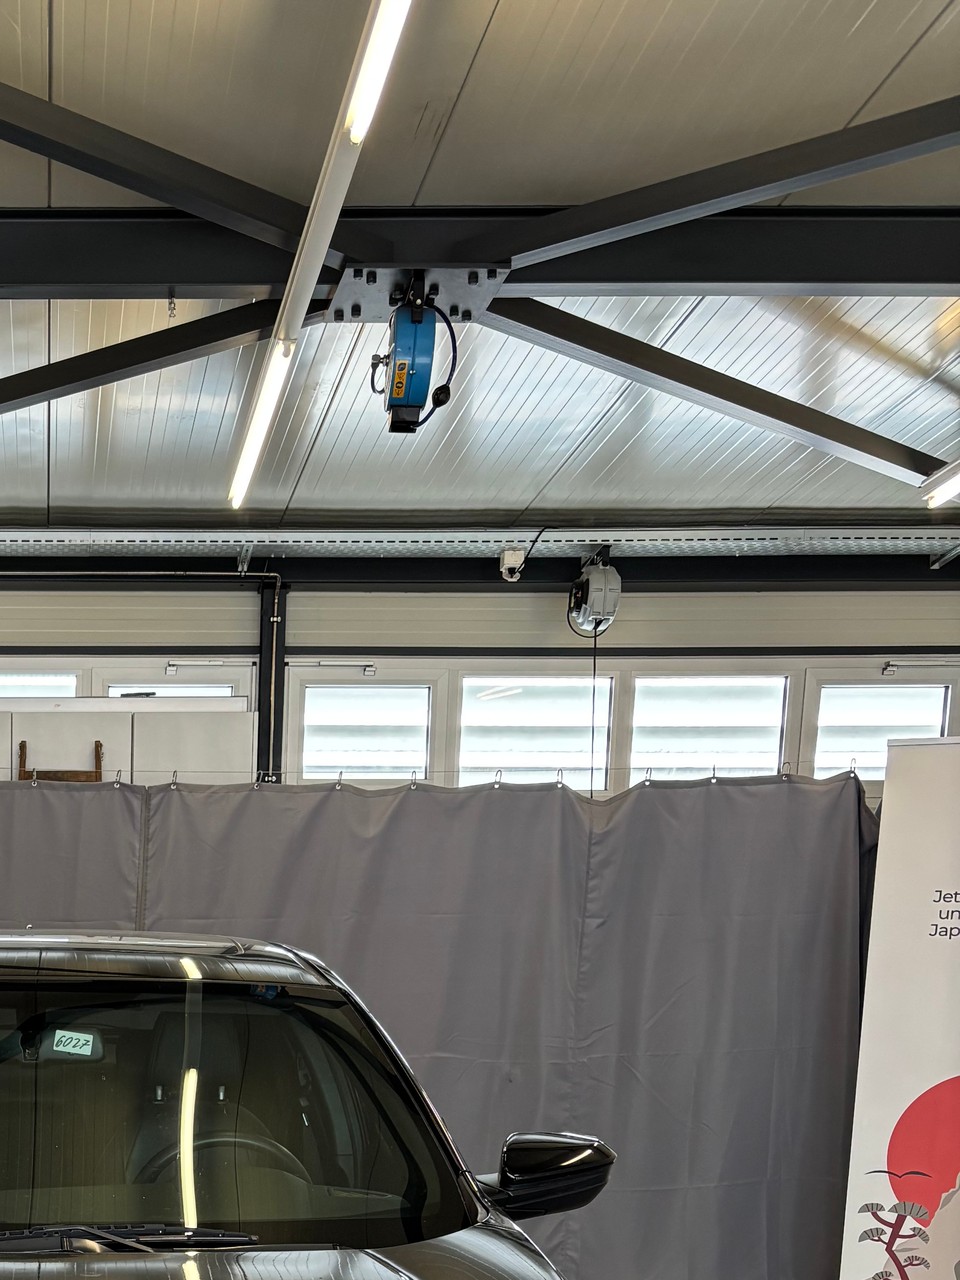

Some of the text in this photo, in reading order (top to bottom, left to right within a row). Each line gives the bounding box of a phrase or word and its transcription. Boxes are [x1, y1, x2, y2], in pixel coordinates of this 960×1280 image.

[933, 890, 960, 903] Jet
[929, 924, 960, 940] Jap
[55, 1035, 91, 1050] 6027
